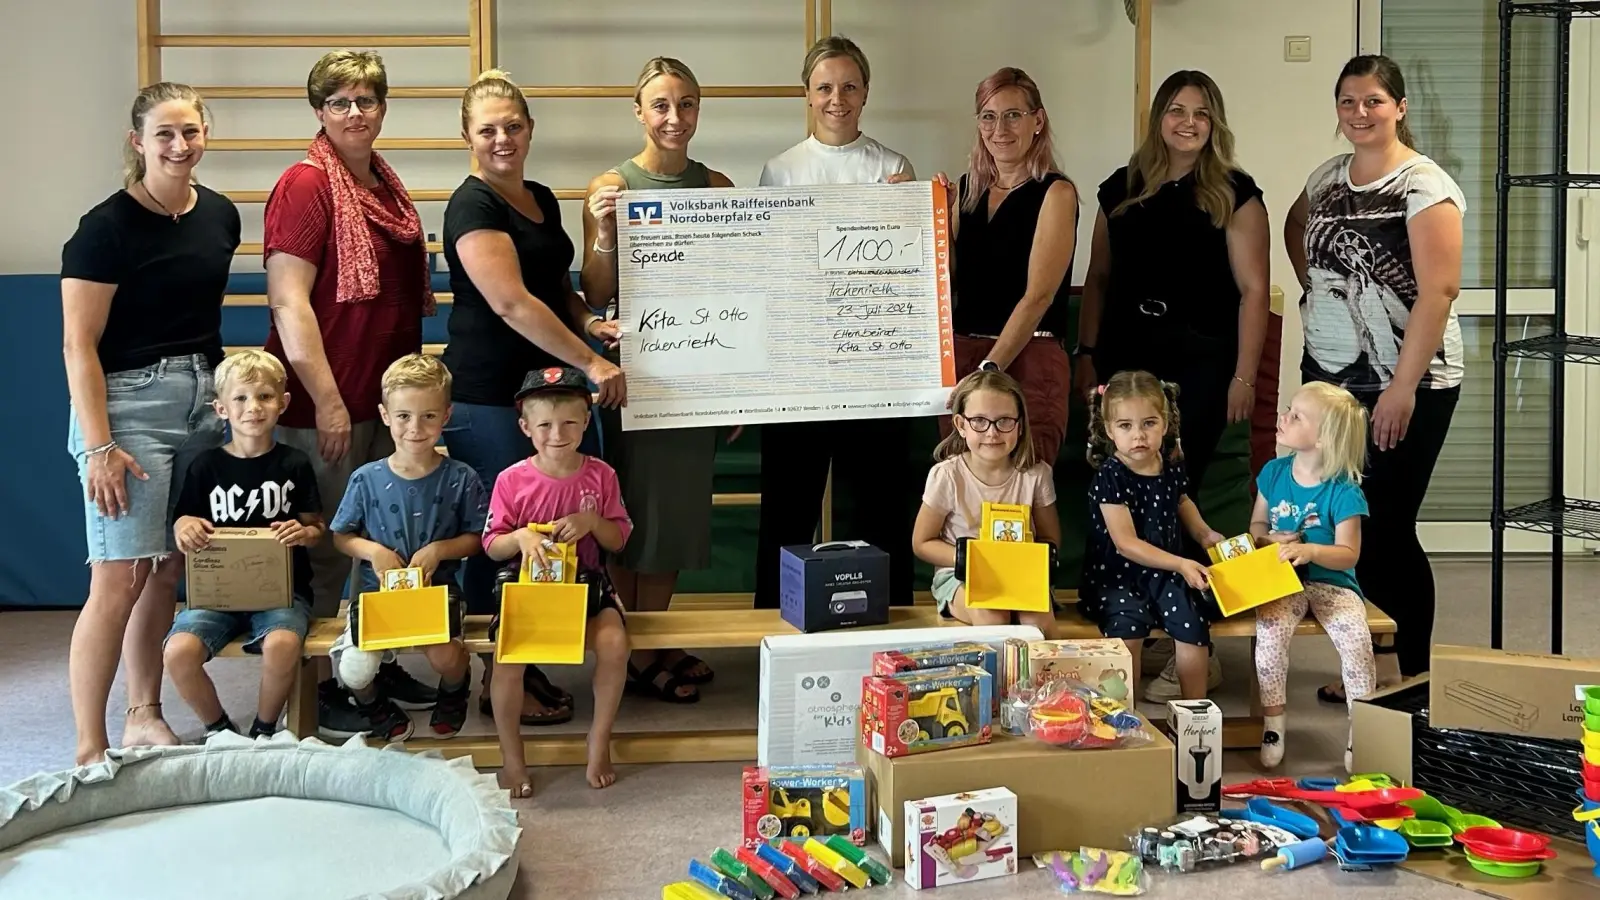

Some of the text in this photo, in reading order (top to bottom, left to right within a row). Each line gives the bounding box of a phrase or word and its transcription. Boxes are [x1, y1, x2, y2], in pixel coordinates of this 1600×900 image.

[670, 196, 815, 211] Volksbank Raiffeisenbank
[669, 211, 771, 224] Nordoberpfalz eG
[836, 225, 879, 233] Spendenbetrag
[630, 249, 685, 269] Spende
[935, 207, 952, 358] SPENDEN-SCHECK
[886, 302, 913, 315] 2024
[638, 307, 682, 333] Kita
[718, 307, 749, 322] Otto
[639, 332, 736, 355] Irchenrieth
[836, 342, 861, 353] Kita
[889, 340, 912, 350] Otto
[835, 572, 863, 581] VOPLLS
[1569, 703, 1584, 713] La
[824, 713, 852, 728] Kids
[1184, 724, 1217, 736] Herbert
[886, 745, 898, 756] 2+
